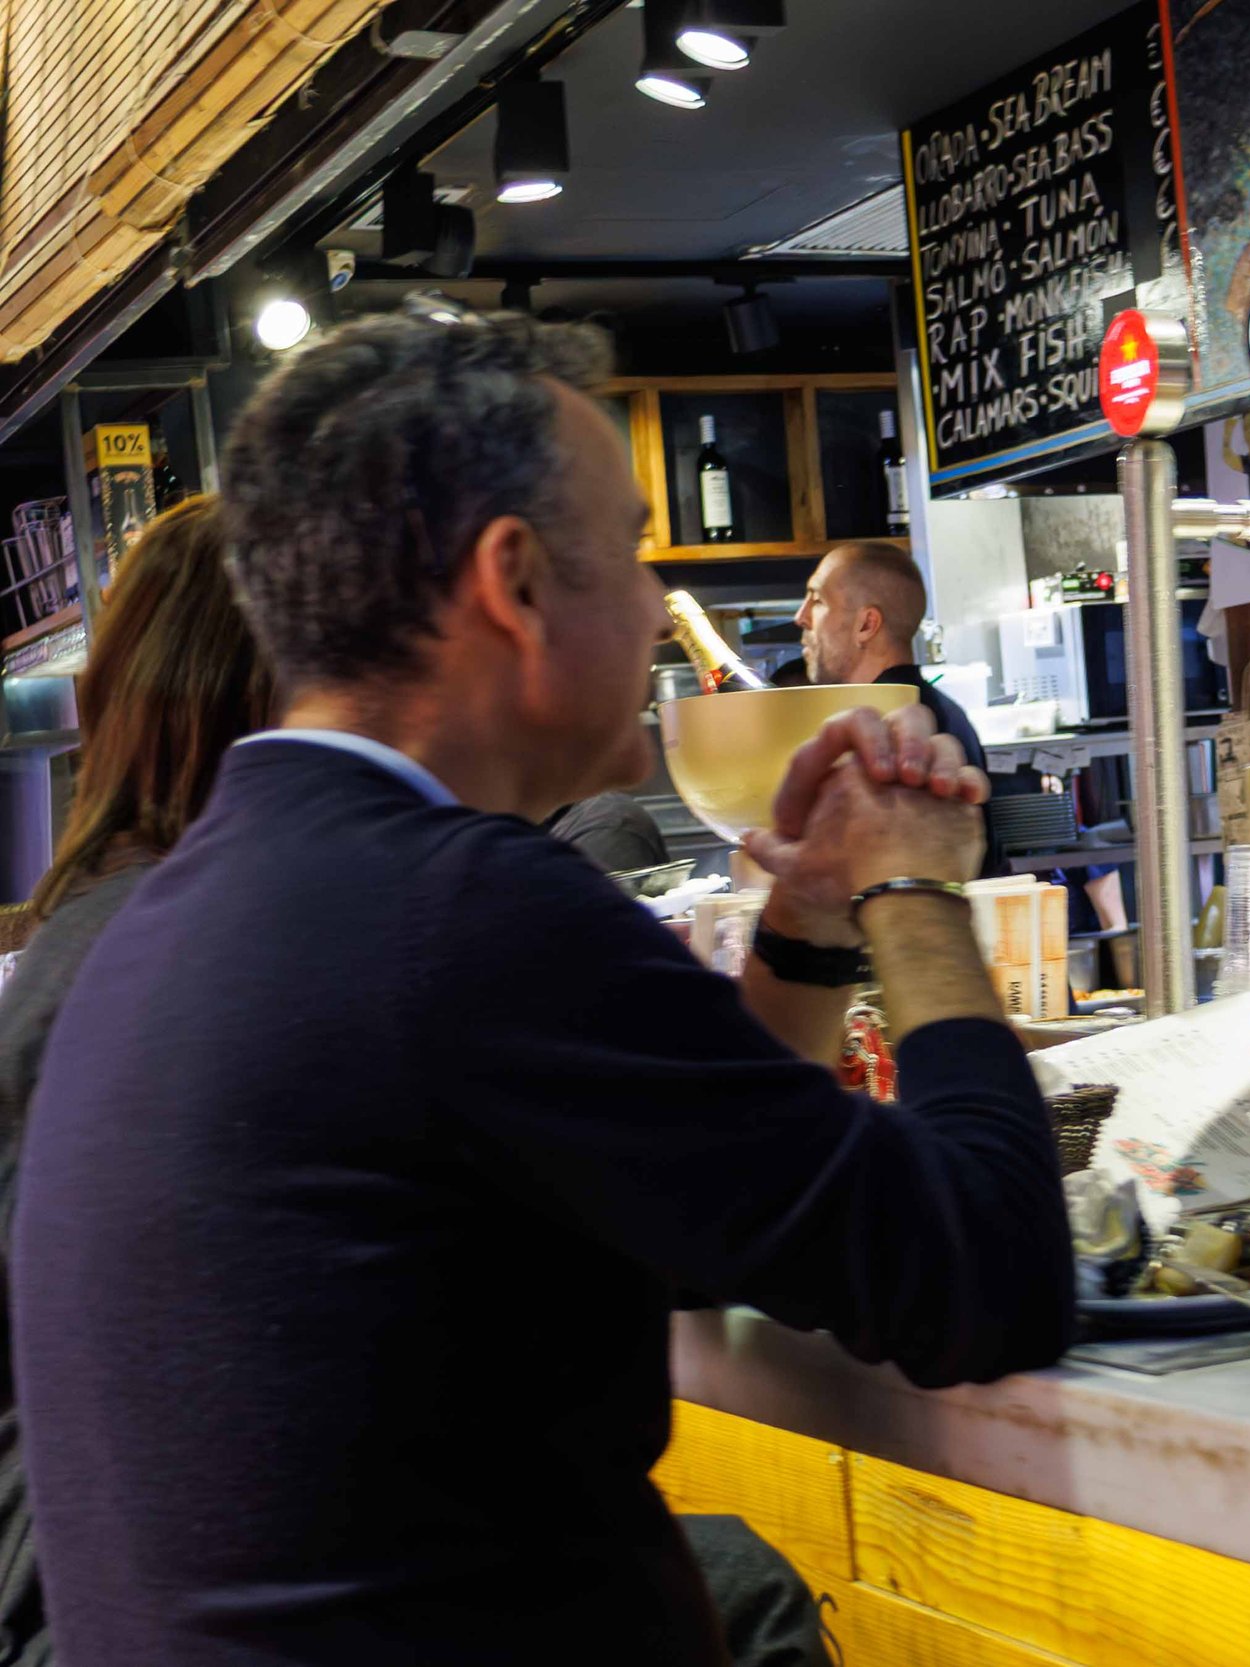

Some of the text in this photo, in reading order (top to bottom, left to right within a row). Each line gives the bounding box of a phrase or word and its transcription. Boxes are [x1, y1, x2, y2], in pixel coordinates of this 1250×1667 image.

[916, 48, 1112, 184] ORADA SEA BREAM
[919, 109, 1114, 236] LLOBARRO SEA BASS
[1019, 172, 1100, 237] TUNA
[926, 249, 1007, 320] SALMÓ
[1021, 205, 1119, 281] SALMÓN
[928, 305, 989, 364] RAP
[103, 433, 144, 454] 10%
[937, 383, 1040, 449] CALAMARS
[1047, 356, 1099, 412] SQUI
